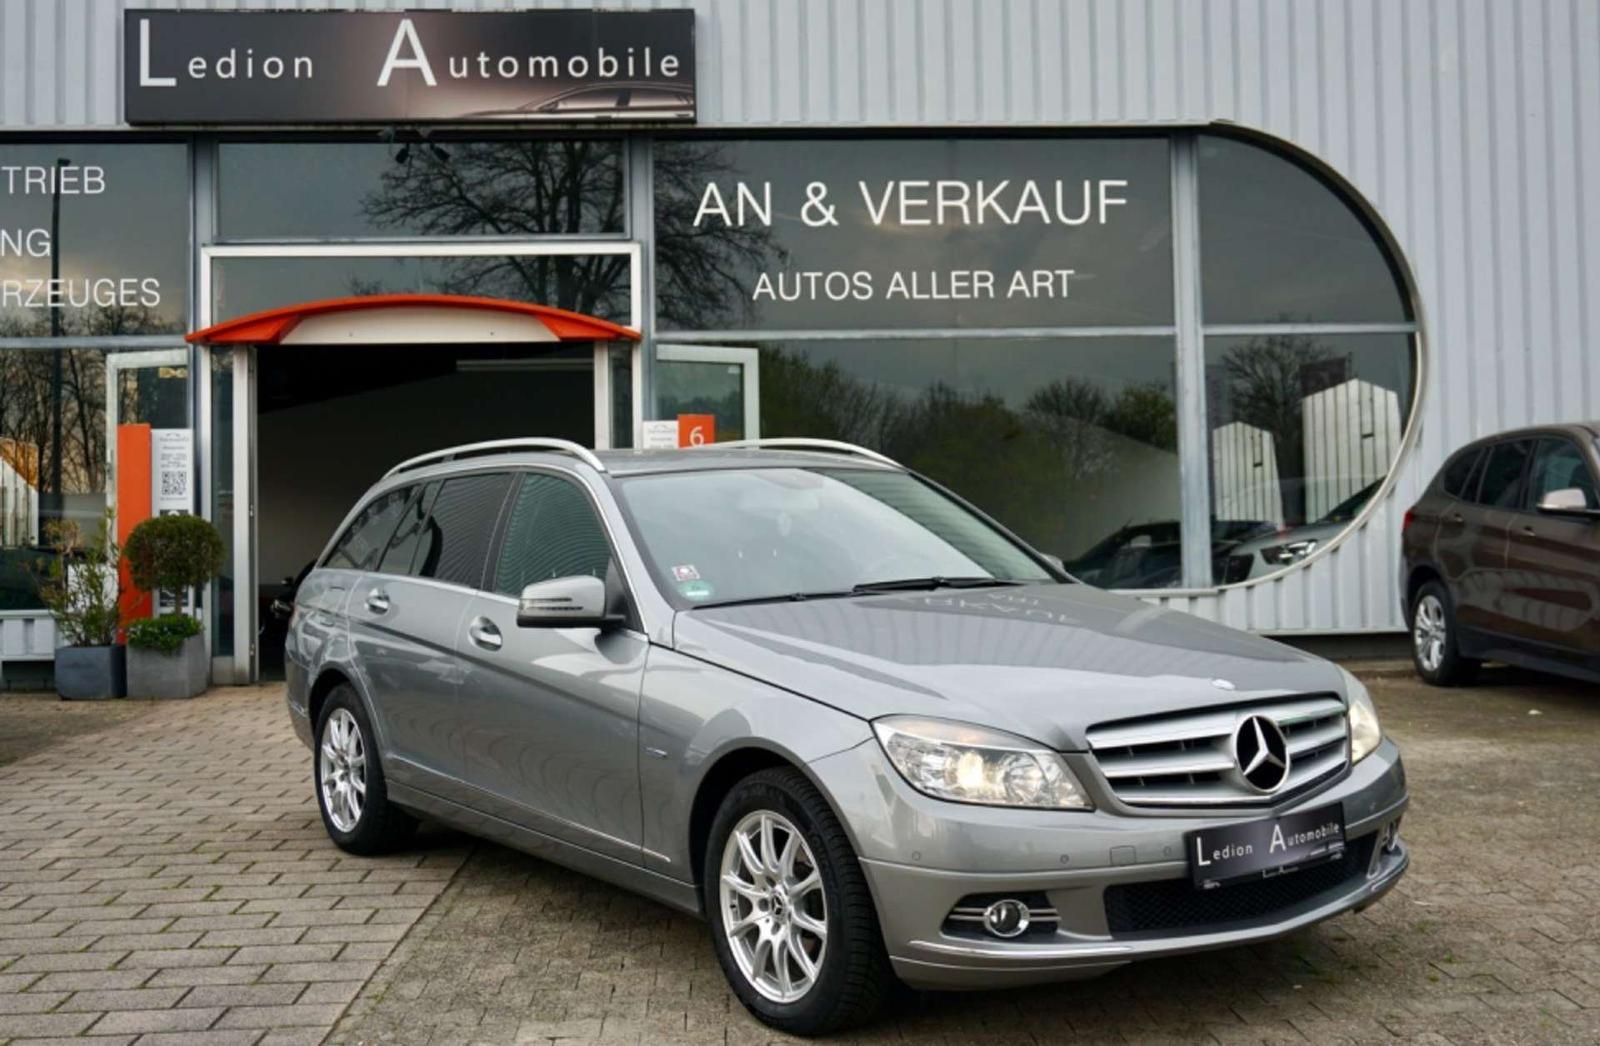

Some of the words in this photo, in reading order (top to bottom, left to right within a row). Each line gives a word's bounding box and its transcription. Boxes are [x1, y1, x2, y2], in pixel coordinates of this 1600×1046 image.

[138, 18, 313, 87] Ledion
[377, 18, 681, 87] Automobile
[0, 165, 106, 195] TRIEB
[692, 180, 773, 227] AN
[799, 180, 840, 227] &
[859, 179, 1129, 226] VERKAUF
[2, 277, 161, 308] RZEUGES
[752, 271, 874, 301] AUTOS
[885, 270, 995, 299] ALLER
[1006, 269, 1076, 298] ART
[690, 426, 704, 447] 6
[1196, 836, 1252, 866] Ledion
[1269, 823, 1340, 853] Automobile
